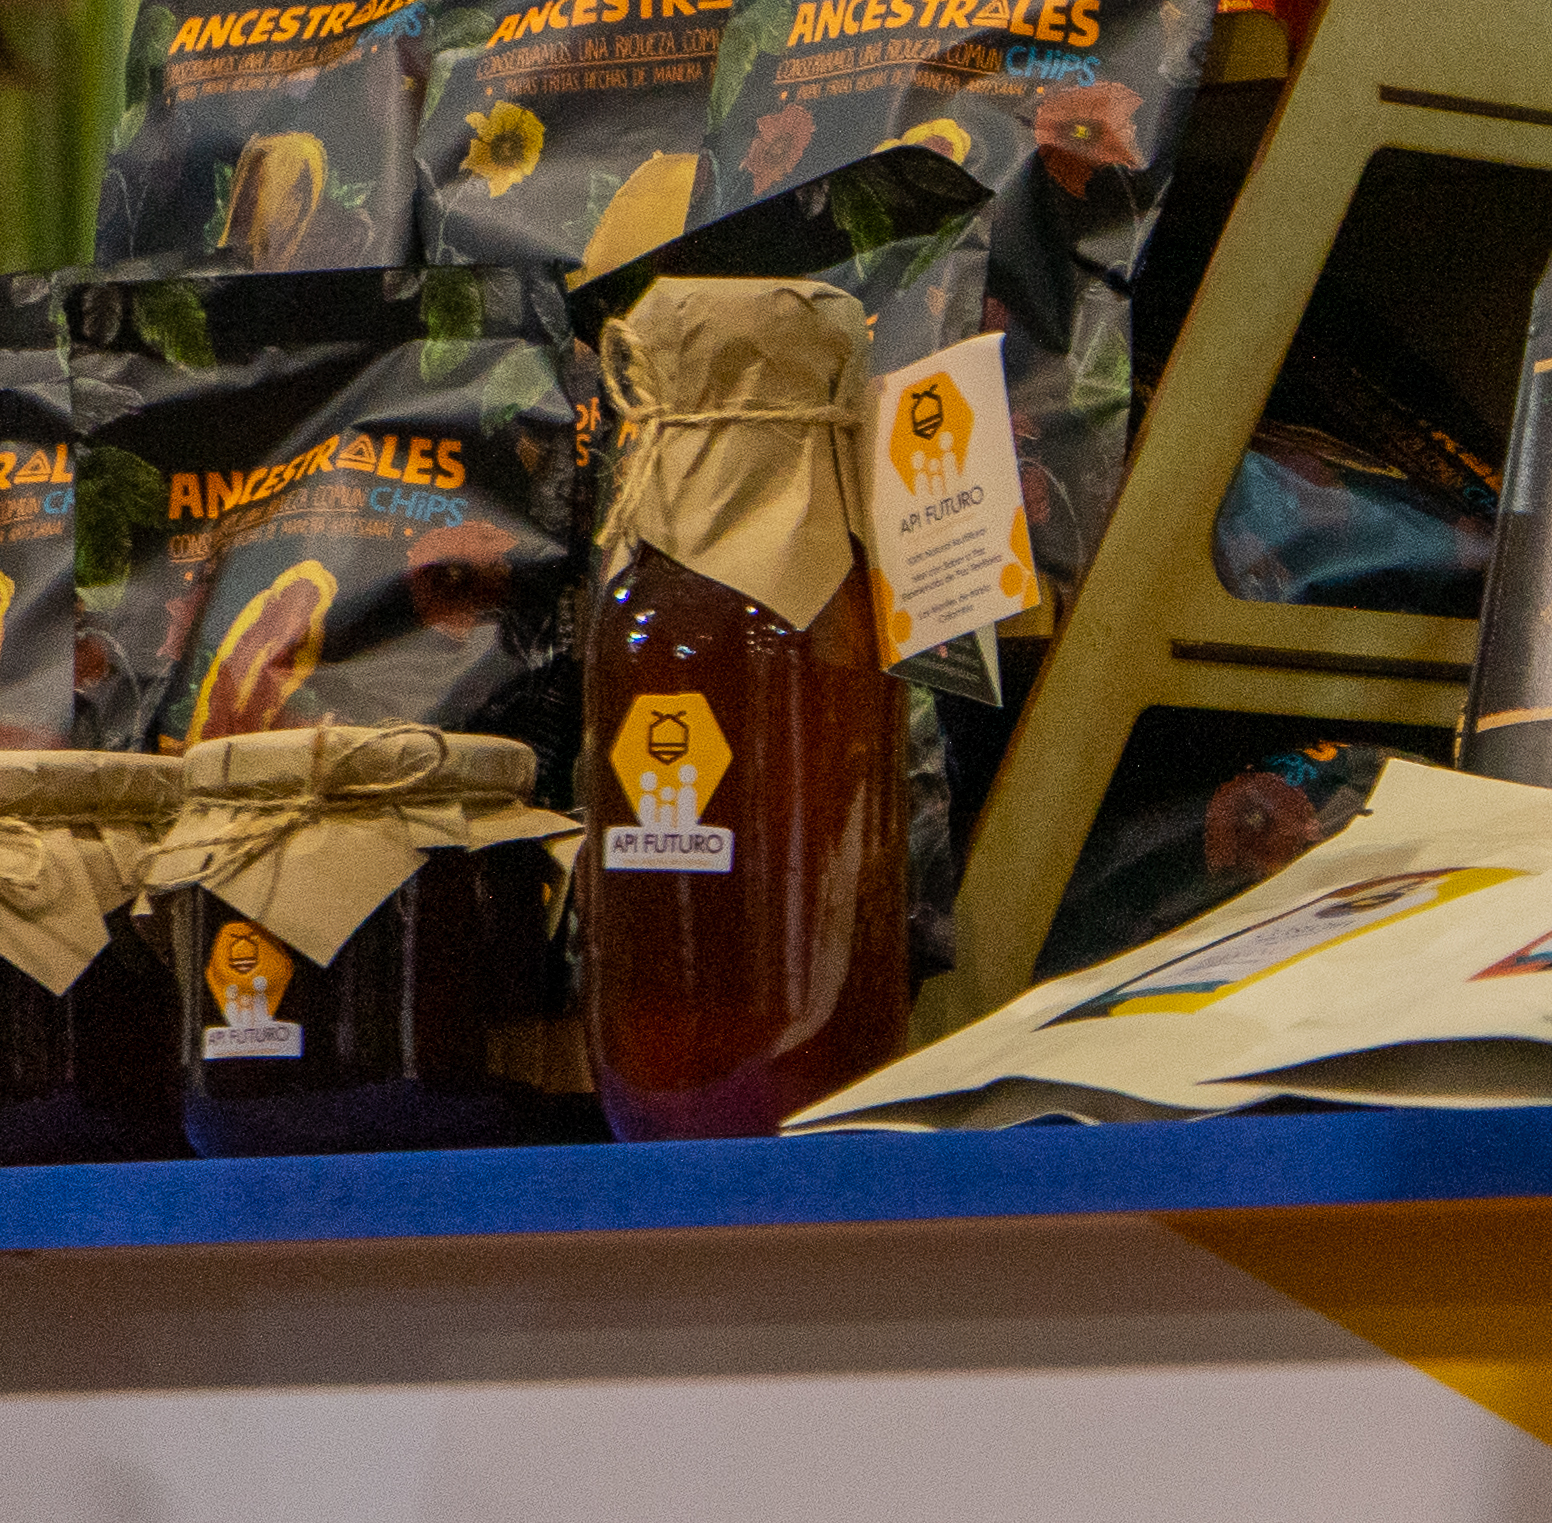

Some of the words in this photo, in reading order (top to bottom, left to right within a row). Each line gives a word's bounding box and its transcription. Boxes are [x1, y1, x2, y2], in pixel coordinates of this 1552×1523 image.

[168, 434, 466, 520] ANCESTRALES
[899, 510, 922, 536] API
[924, 484, 985, 525] FUTURO
[613, 833, 638, 854] API
[643, 832, 725, 855] FUTURO
